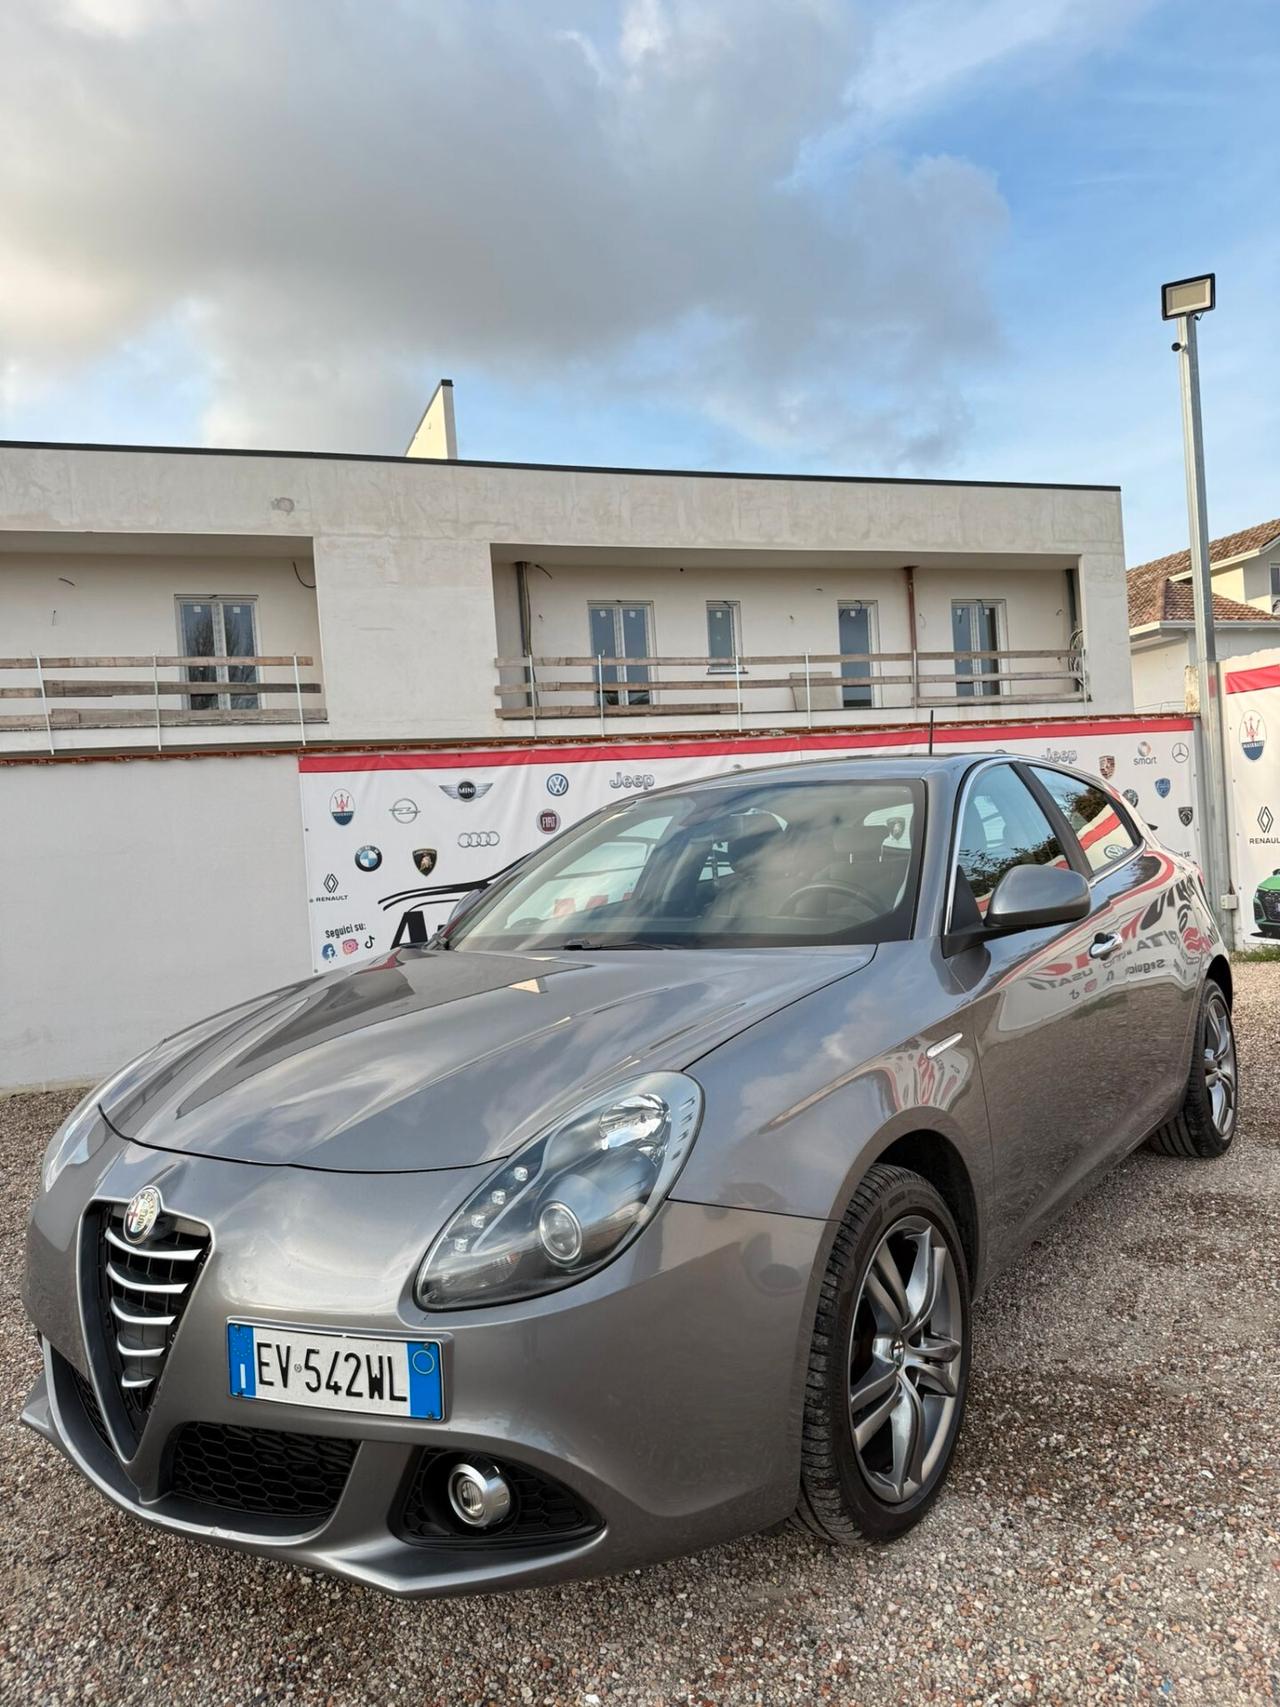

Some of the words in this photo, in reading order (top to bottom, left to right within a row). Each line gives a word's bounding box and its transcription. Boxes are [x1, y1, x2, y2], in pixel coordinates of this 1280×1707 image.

[1041, 747, 1077, 764] Jeep
[1133, 756, 1157, 765] smart
[609, 772, 655, 790] Jeep
[542, 816, 556, 828] FIAT
[316, 894, 349, 902] RENAULT
[325, 925, 354, 939] Seguici
[354, 922, 367, 932] su:
[256, 1341, 291, 1388] EV
[304, 1348, 408, 1402] 542WL
